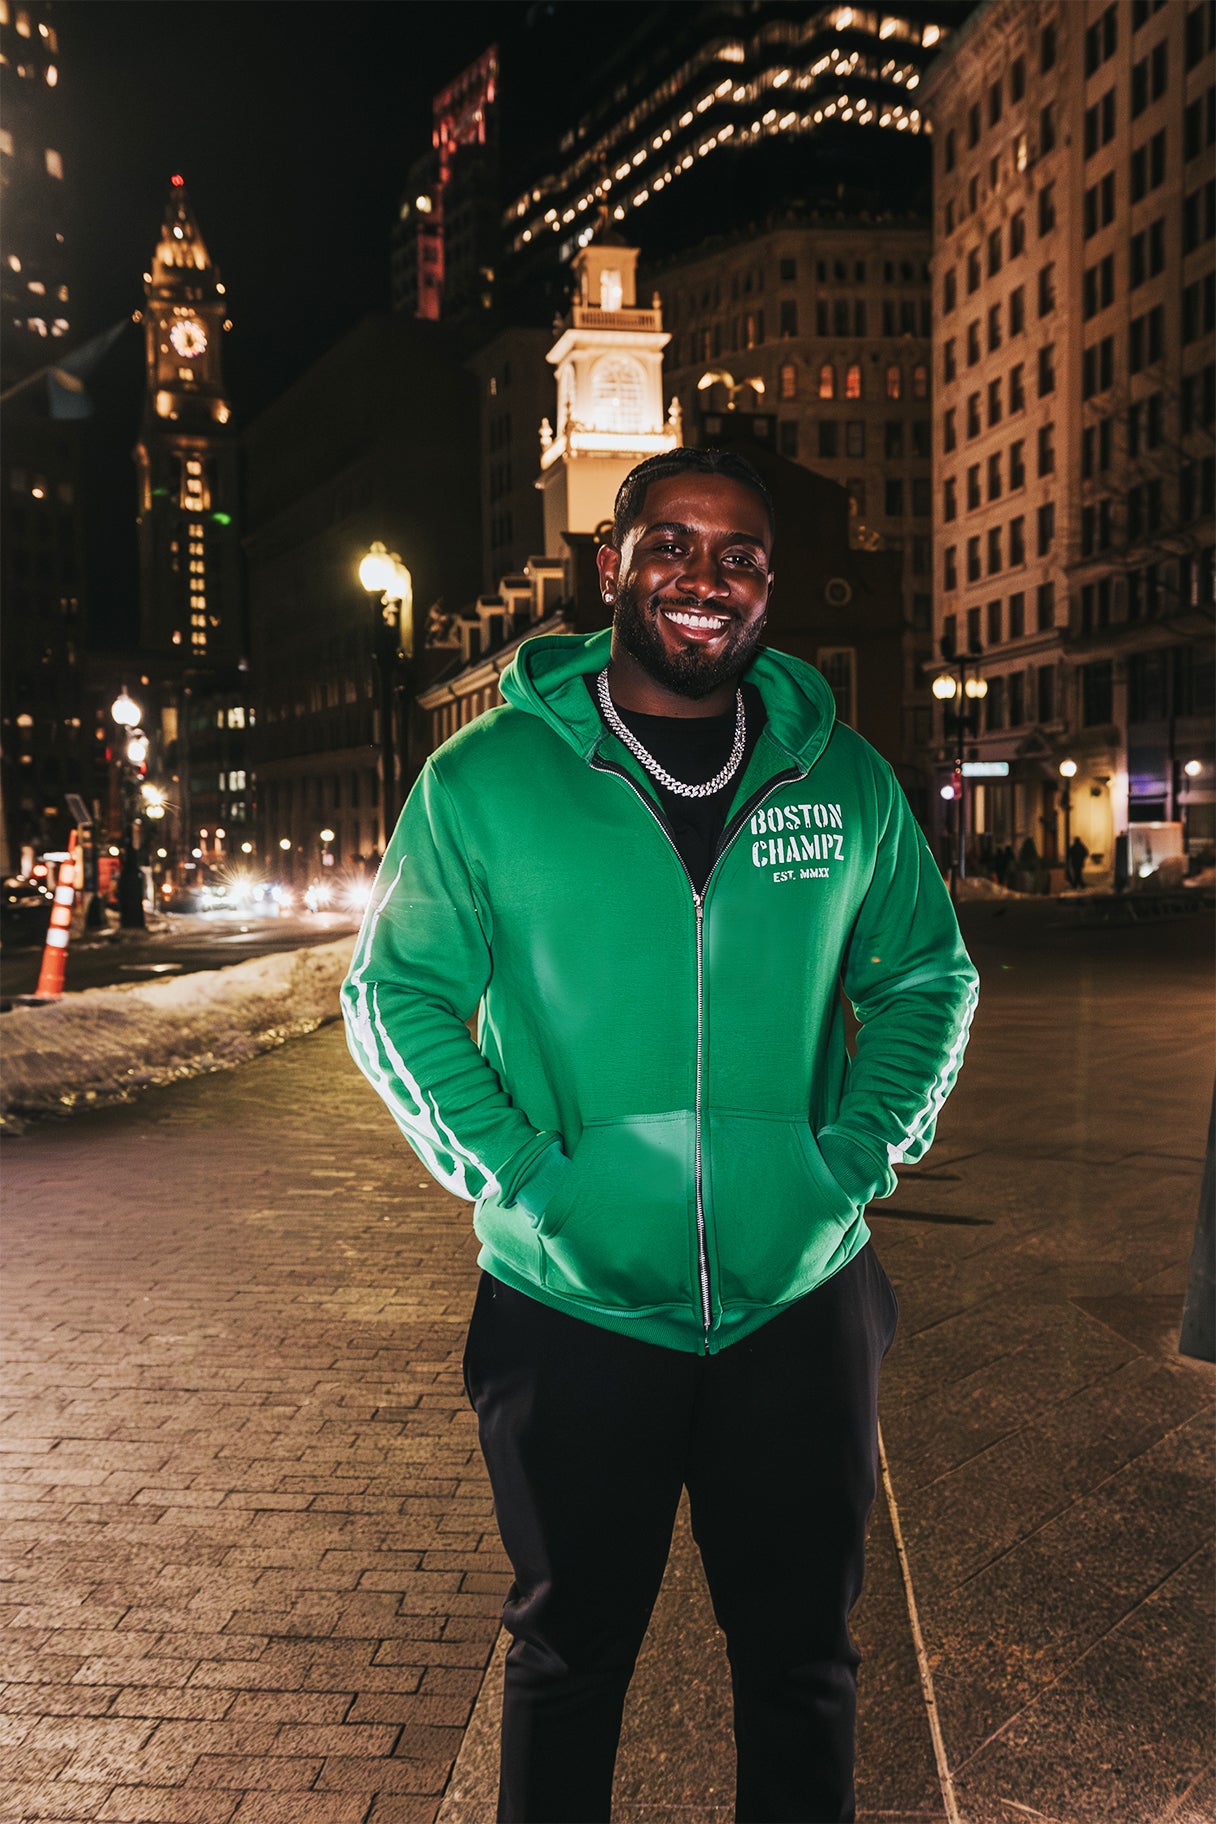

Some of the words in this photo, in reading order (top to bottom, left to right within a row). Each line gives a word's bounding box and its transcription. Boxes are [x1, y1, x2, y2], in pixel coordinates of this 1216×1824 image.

[751, 804, 843, 835] BOSTON
[752, 834, 845, 868] CHAMPZ
[773, 870, 797, 883] EST.
[799, 867, 830, 880] MMXX
